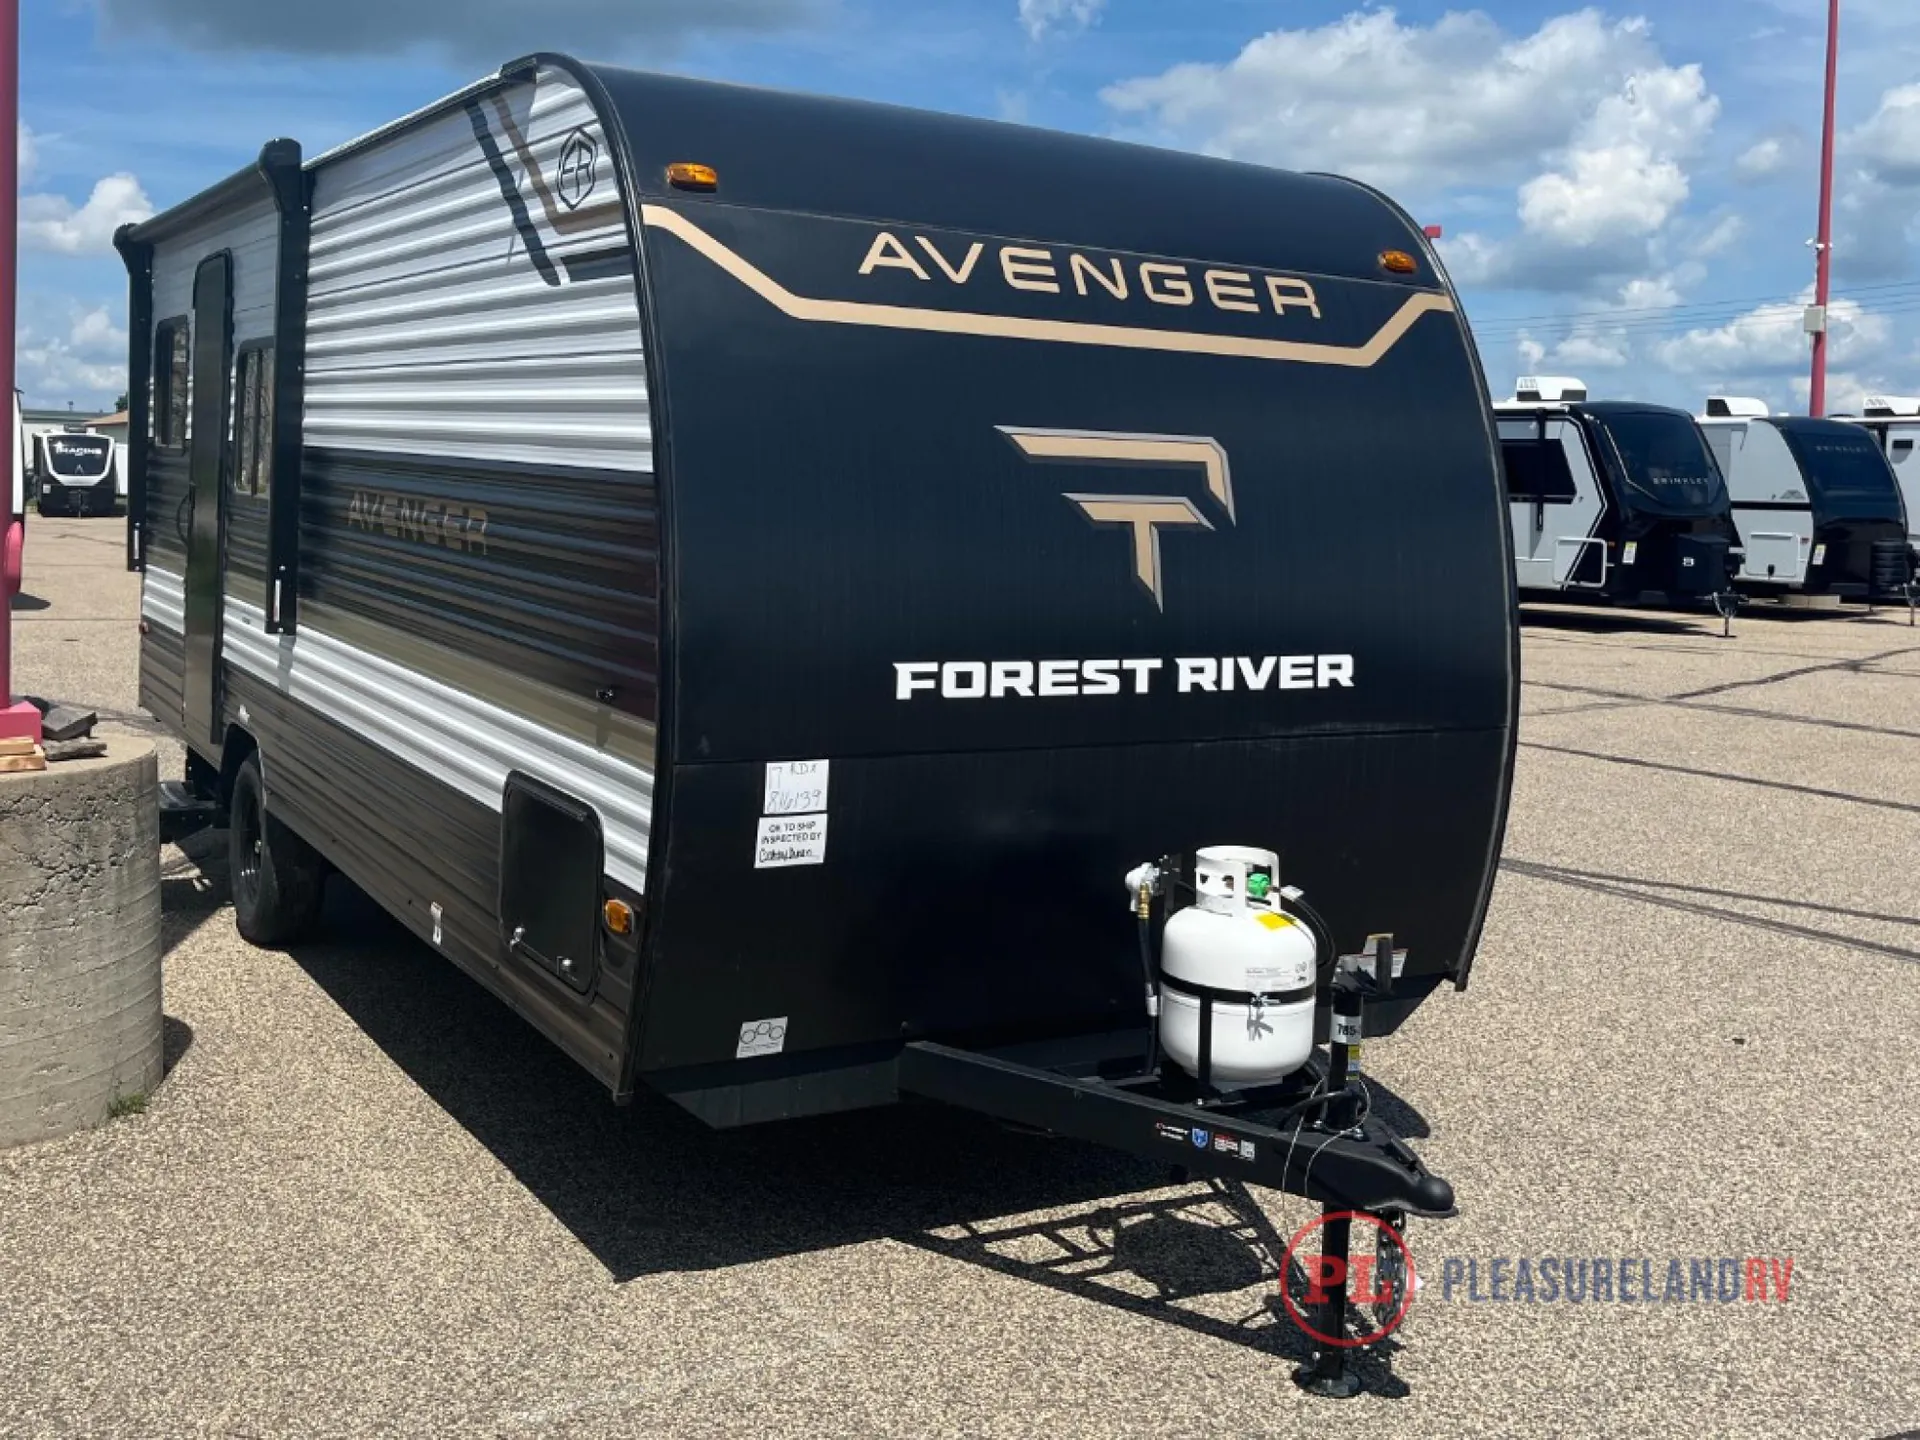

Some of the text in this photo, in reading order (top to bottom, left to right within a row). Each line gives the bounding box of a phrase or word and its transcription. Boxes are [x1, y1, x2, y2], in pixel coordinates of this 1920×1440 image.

[858, 232, 1320, 319] AVENGER
[348, 491, 488, 556] AVENGER
[893, 654, 1355, 700] FOREST RIVER
[761, 832, 822, 844] INSPECTED BY
[784, 822, 796, 831] TO
[797, 821, 816, 831] SHIP
